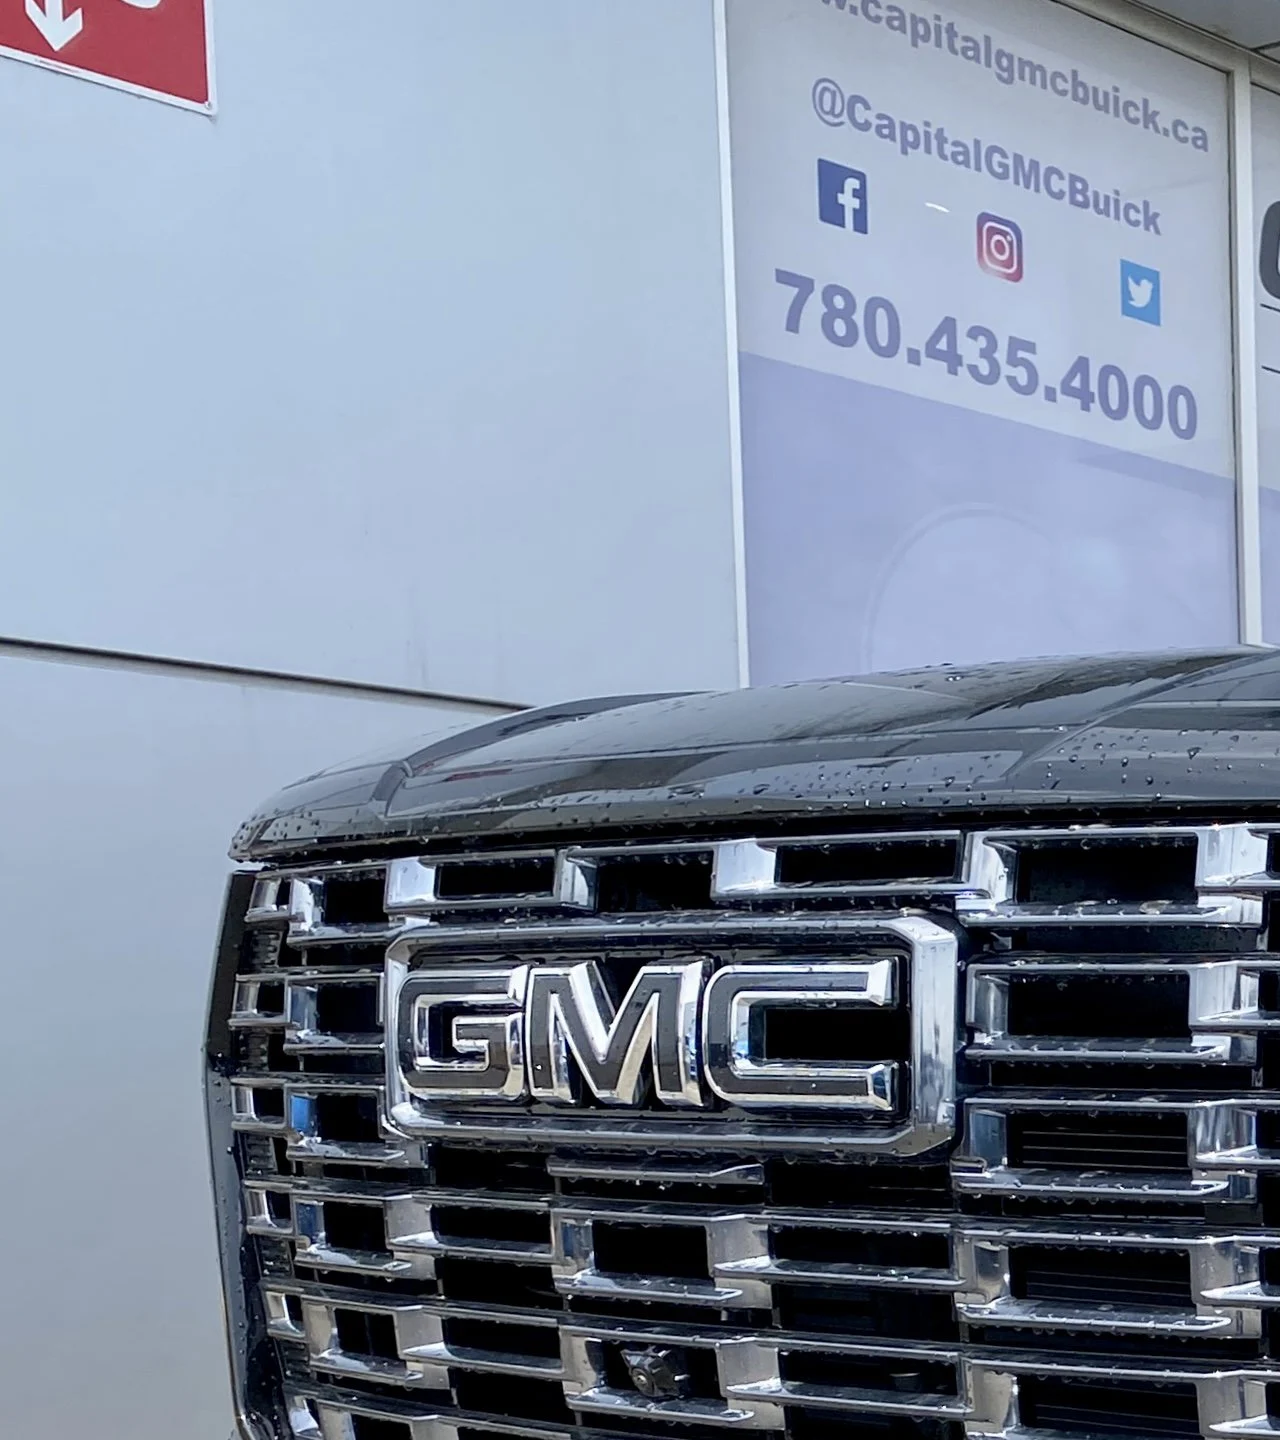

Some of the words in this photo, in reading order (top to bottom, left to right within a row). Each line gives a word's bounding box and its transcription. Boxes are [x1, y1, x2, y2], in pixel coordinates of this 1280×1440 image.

[812, 78, 1162, 235] @CapitalGMCBuick
[774, 268, 1198, 441] 780.435.4000
[397, 954, 900, 1113] GMC
